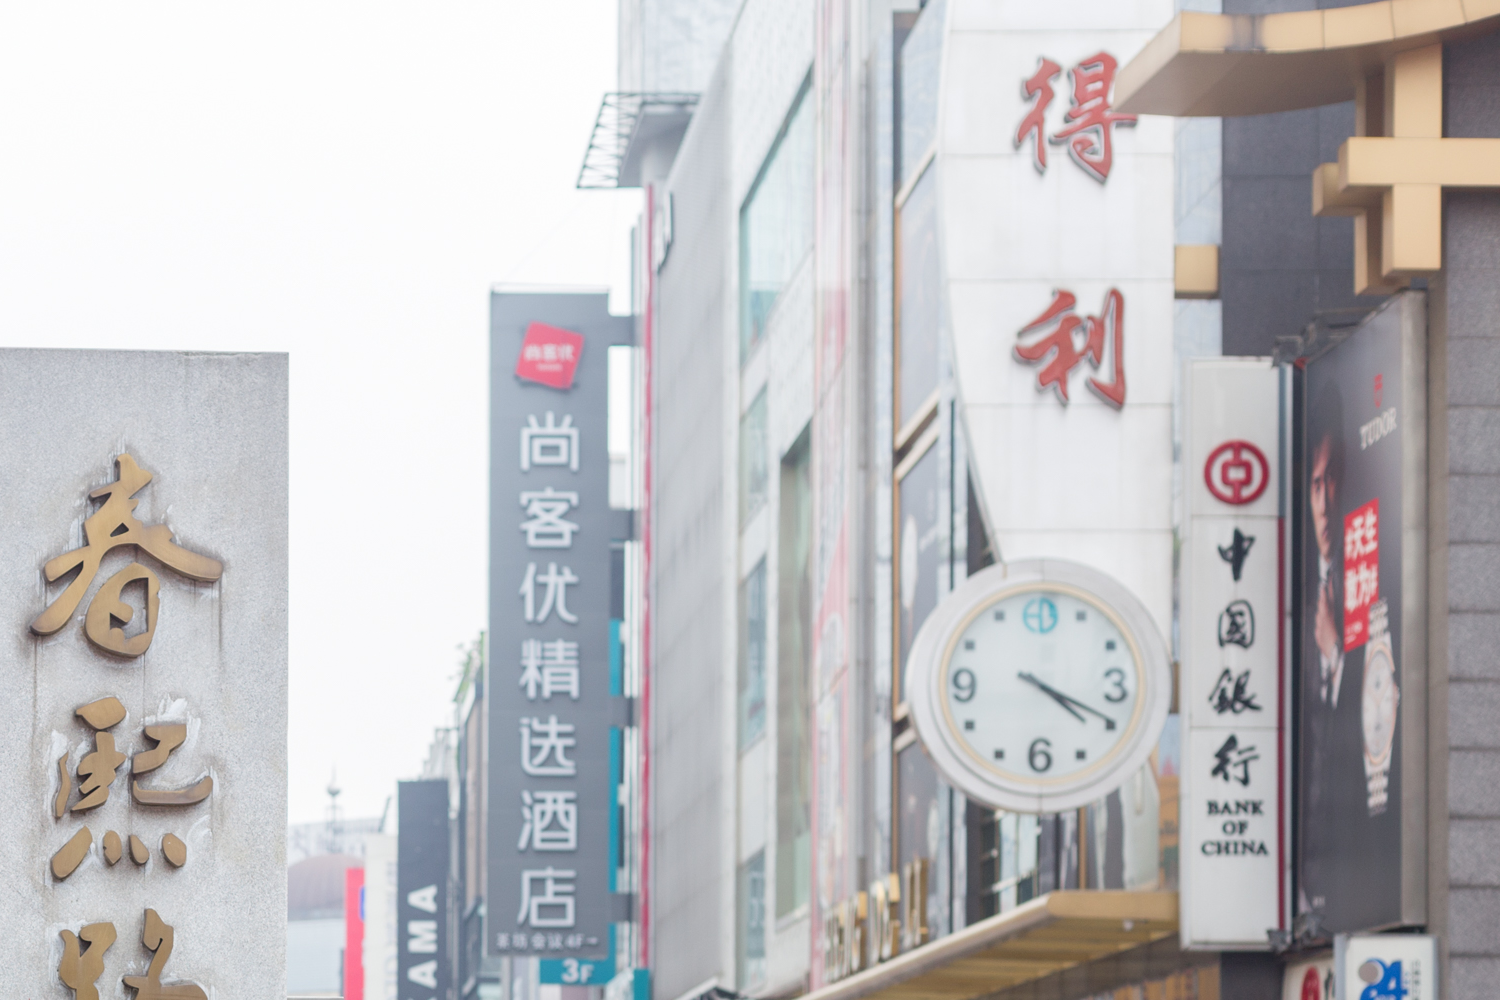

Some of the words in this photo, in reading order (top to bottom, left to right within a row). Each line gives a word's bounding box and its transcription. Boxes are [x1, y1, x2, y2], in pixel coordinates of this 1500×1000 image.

[1013, 51, 1138, 412] 得利
[1360, 406, 1397, 450] TUDOR
[517, 410, 579, 928] 尚客优精选酒店
[952, 667, 977, 704] 9
[1104, 667, 1129, 704] 3
[1028, 738, 1053, 774] 6
[1207, 800, 1264, 816] BANK
[1222, 821, 1248, 837] OF
[1201, 840, 1268, 857] CHINA
[561, 957, 595, 984] 3F
